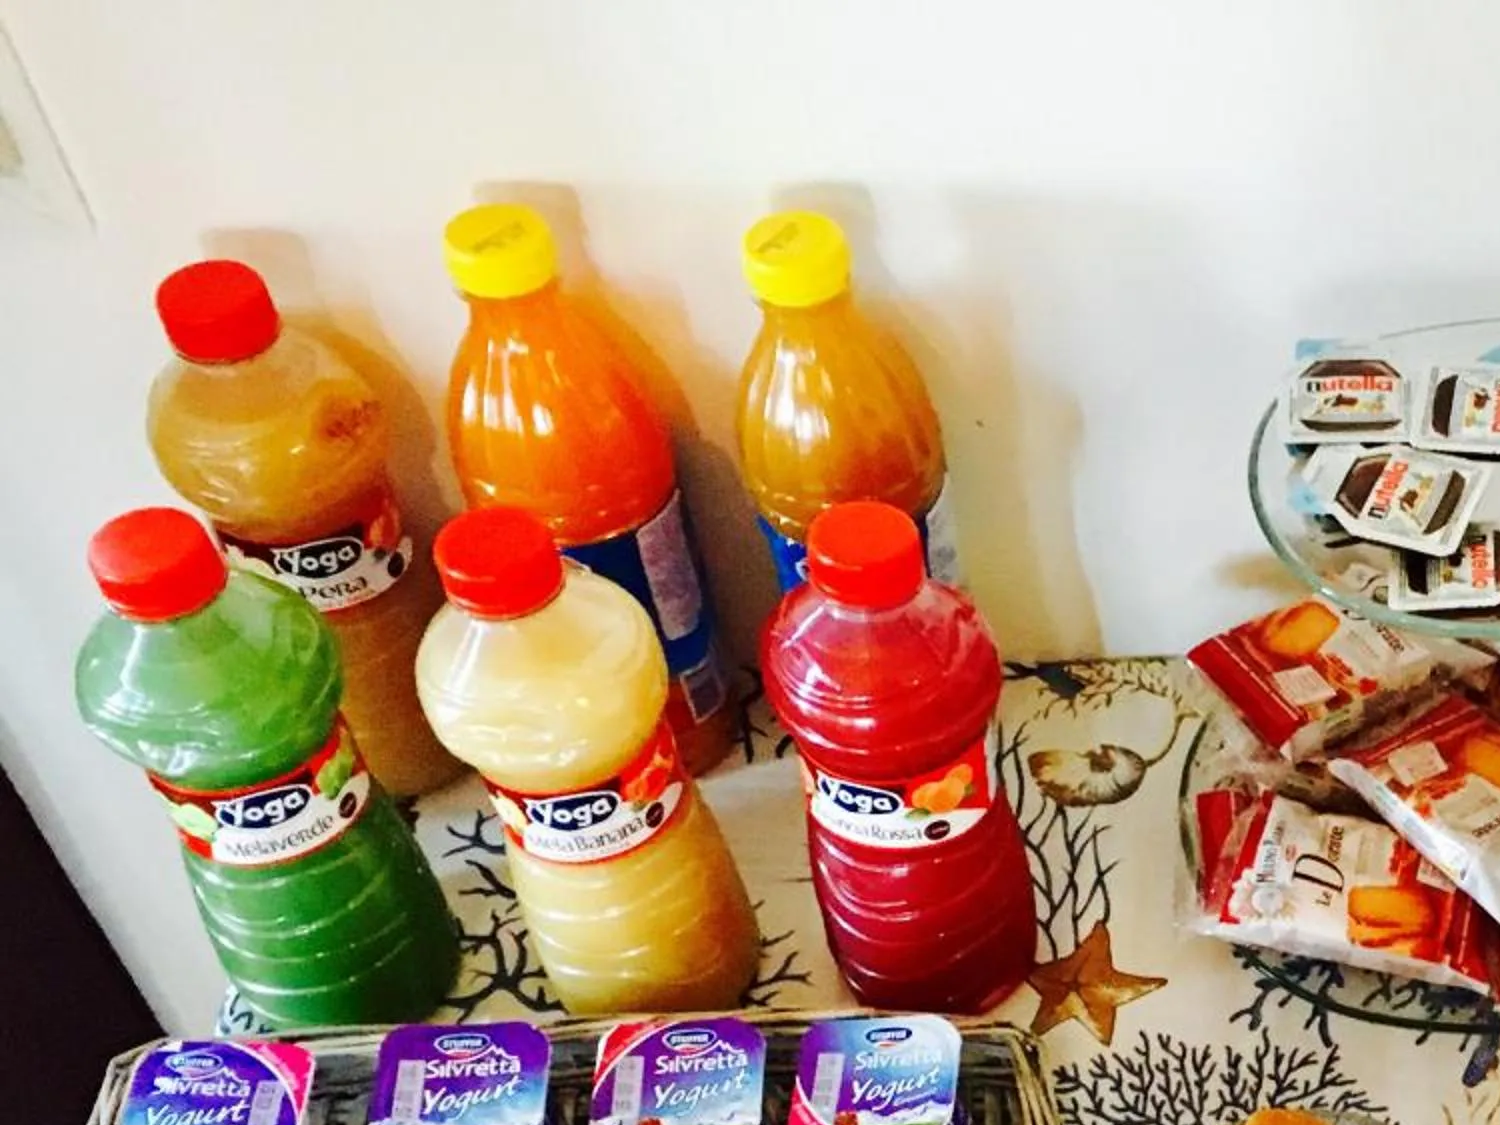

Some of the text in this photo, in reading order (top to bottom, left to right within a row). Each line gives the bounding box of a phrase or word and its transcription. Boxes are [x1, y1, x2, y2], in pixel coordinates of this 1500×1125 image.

[1306, 371, 1393, 392] nutella
[1368, 460, 1409, 519] nutella
[281, 546, 355, 574] Yoga
[222, 791, 305, 825] Yoga
[535, 798, 612, 827] Yoga
[824, 780, 894, 814] Yoga
[424, 1056, 521, 1080] Silvretta
[654, 1052, 748, 1075] Silvretta
[855, 1048, 943, 1069] Silvretta
[423, 1077, 519, 1120] Yogurt
[654, 1070, 747, 1114] Yogurt
[852, 1067, 941, 1111] Yogurt
